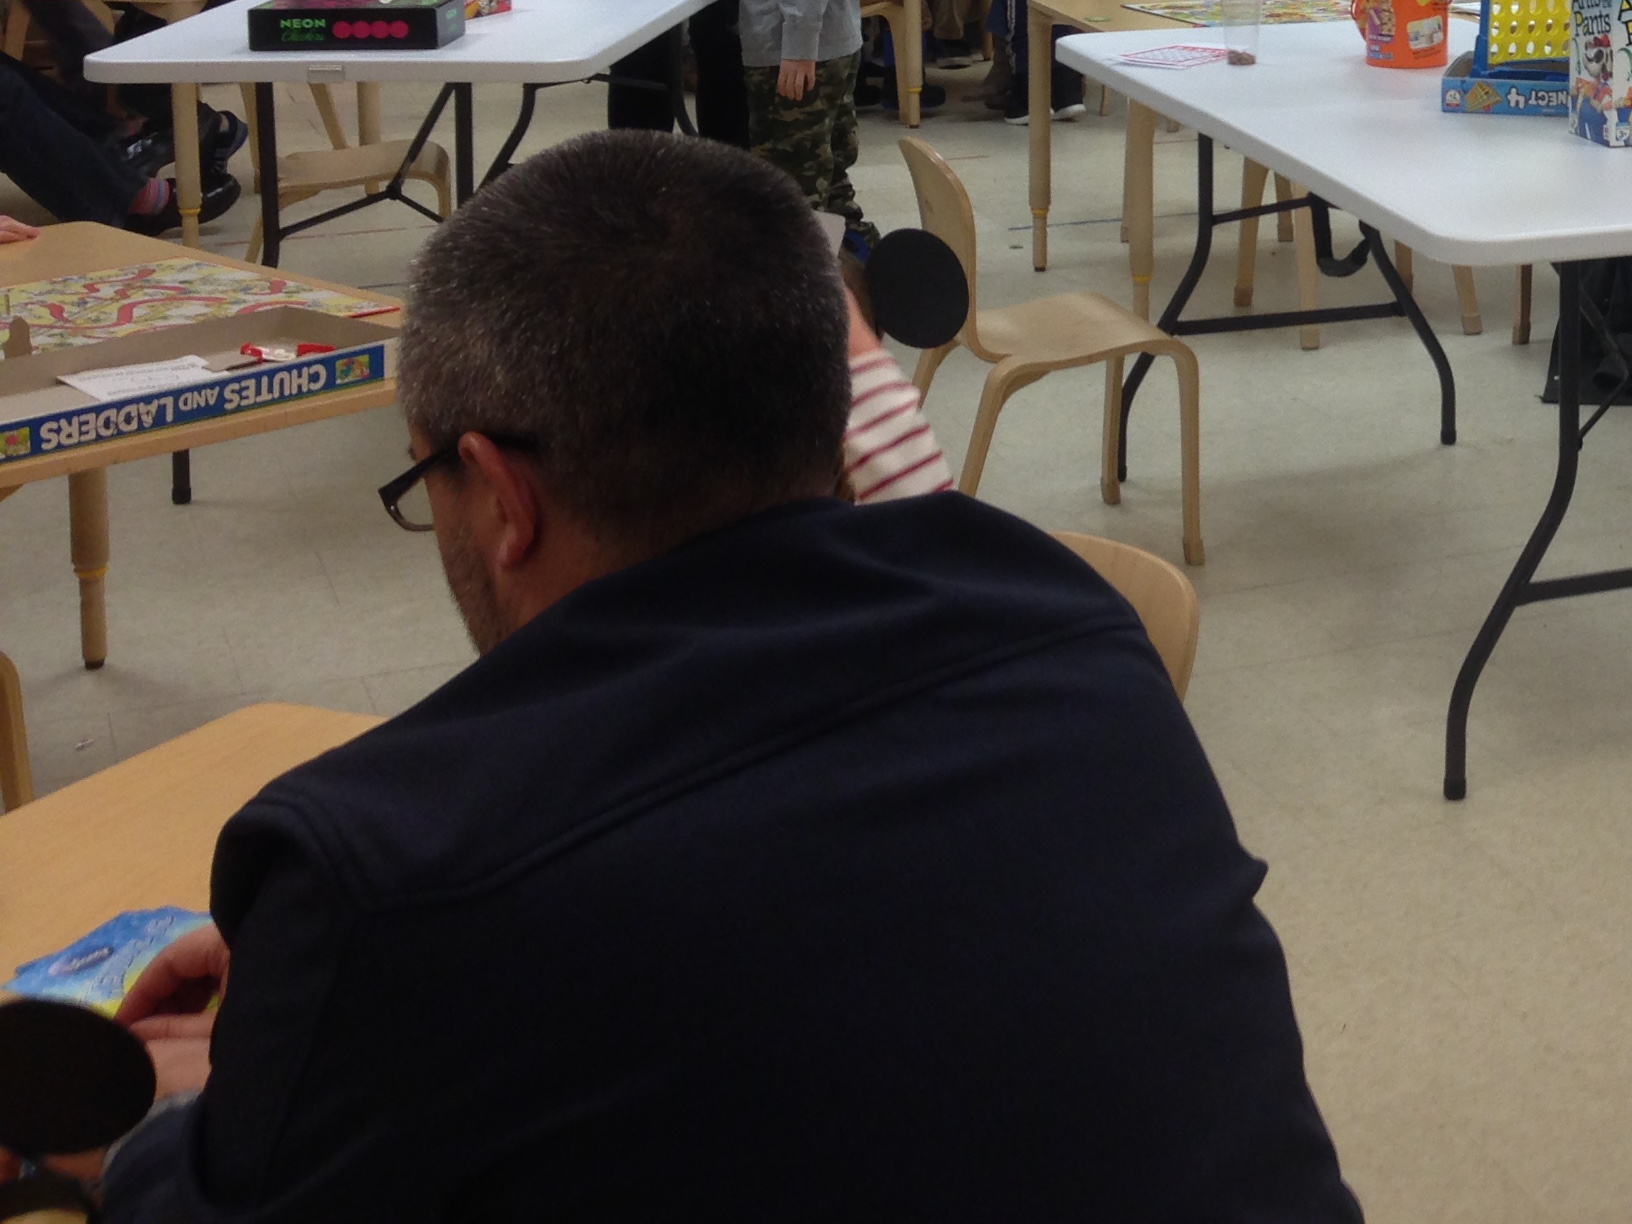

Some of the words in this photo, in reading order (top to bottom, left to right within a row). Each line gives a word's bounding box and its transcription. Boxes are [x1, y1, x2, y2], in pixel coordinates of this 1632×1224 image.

[280, 18, 327, 29] NEON
[1573, 10, 1611, 37] Pants
[1507, 87, 1525, 109] 4
[223, 363, 327, 410] CHUTES
[179, 388, 219, 411] AND
[39, 397, 175, 452] LADDERS
